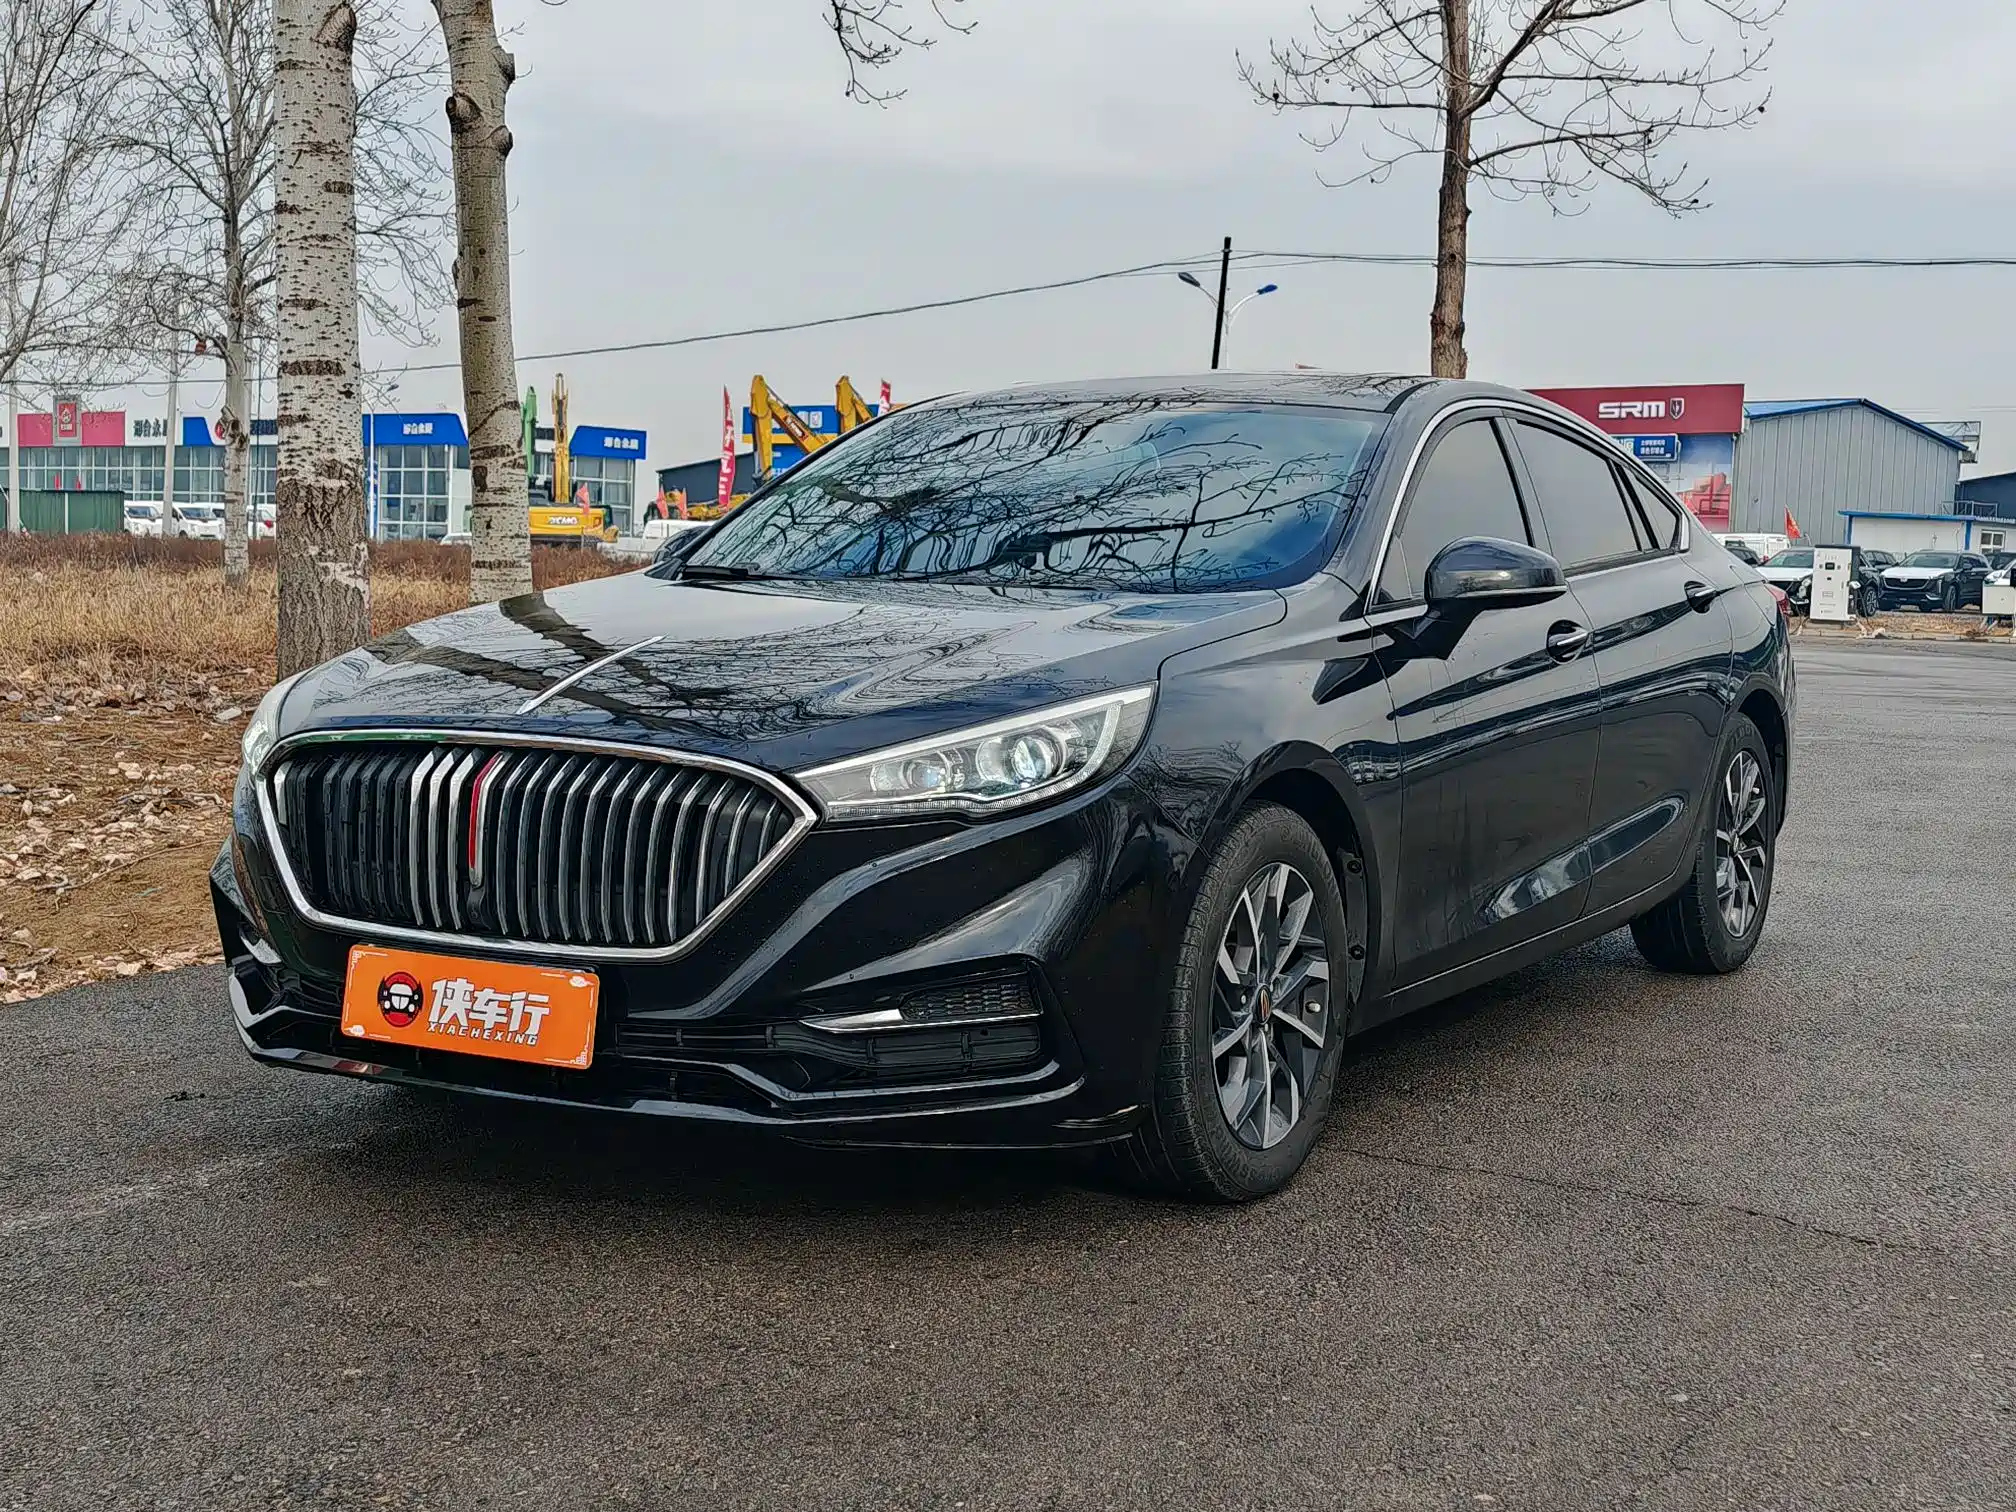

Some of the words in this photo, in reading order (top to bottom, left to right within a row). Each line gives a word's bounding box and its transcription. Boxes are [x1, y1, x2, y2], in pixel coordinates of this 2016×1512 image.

[1598, 401, 1666, 419] SRM
[427, 976, 551, 1036] 侠车行
[426, 1020, 540, 1047] XIACHEXING
